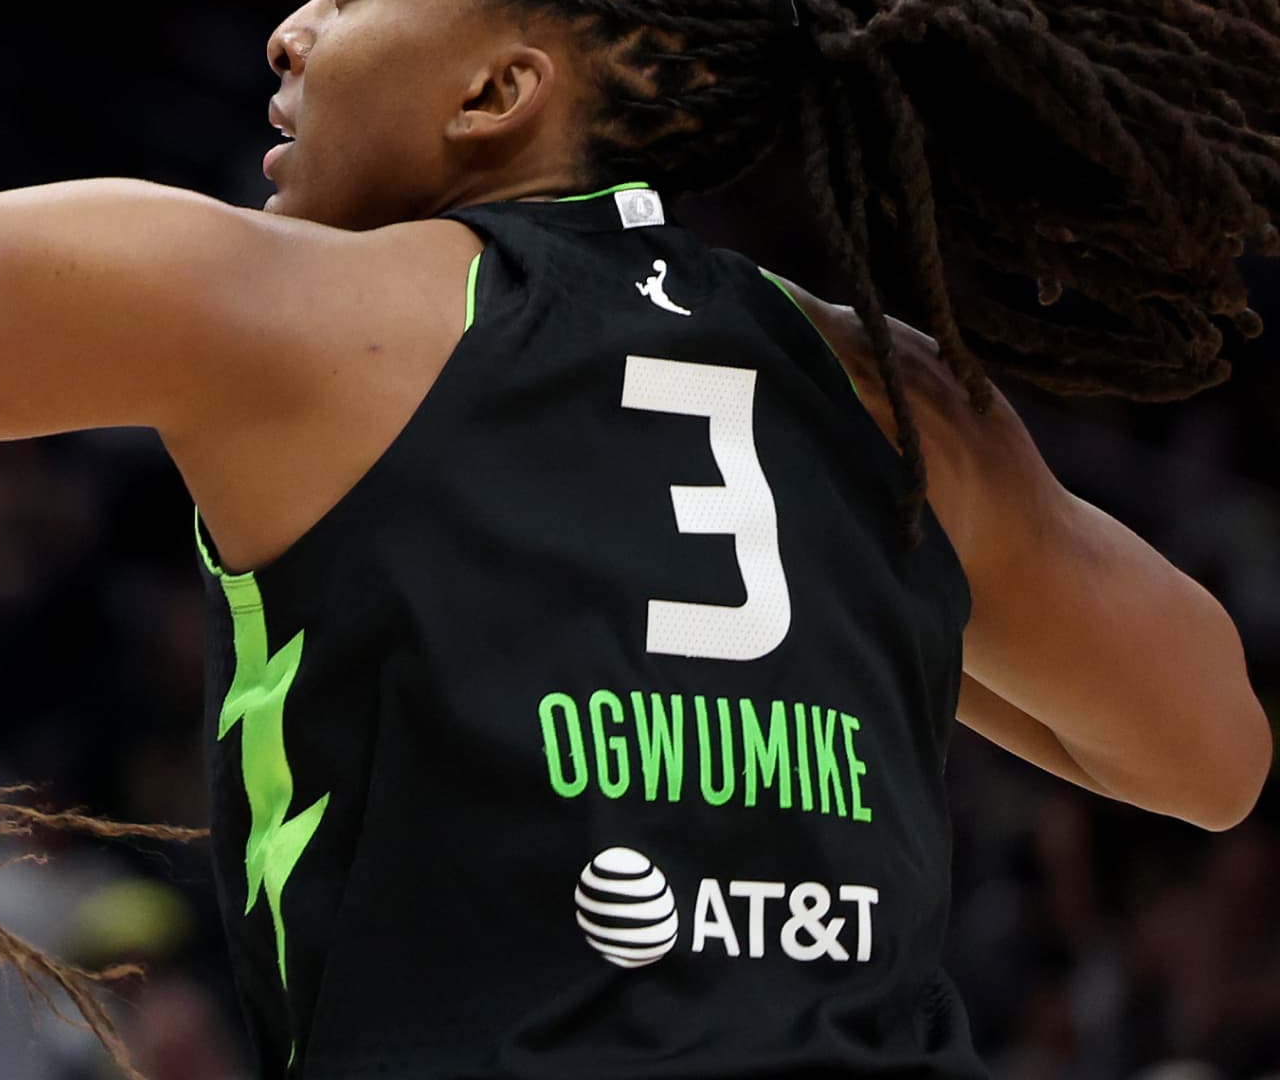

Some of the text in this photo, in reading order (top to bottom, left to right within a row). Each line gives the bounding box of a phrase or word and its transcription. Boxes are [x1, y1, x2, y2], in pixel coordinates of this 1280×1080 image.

[621, 354, 792, 662] 3
[538, 689, 873, 823] OGWUMIKE
[691, 877, 880, 963] AT&T
